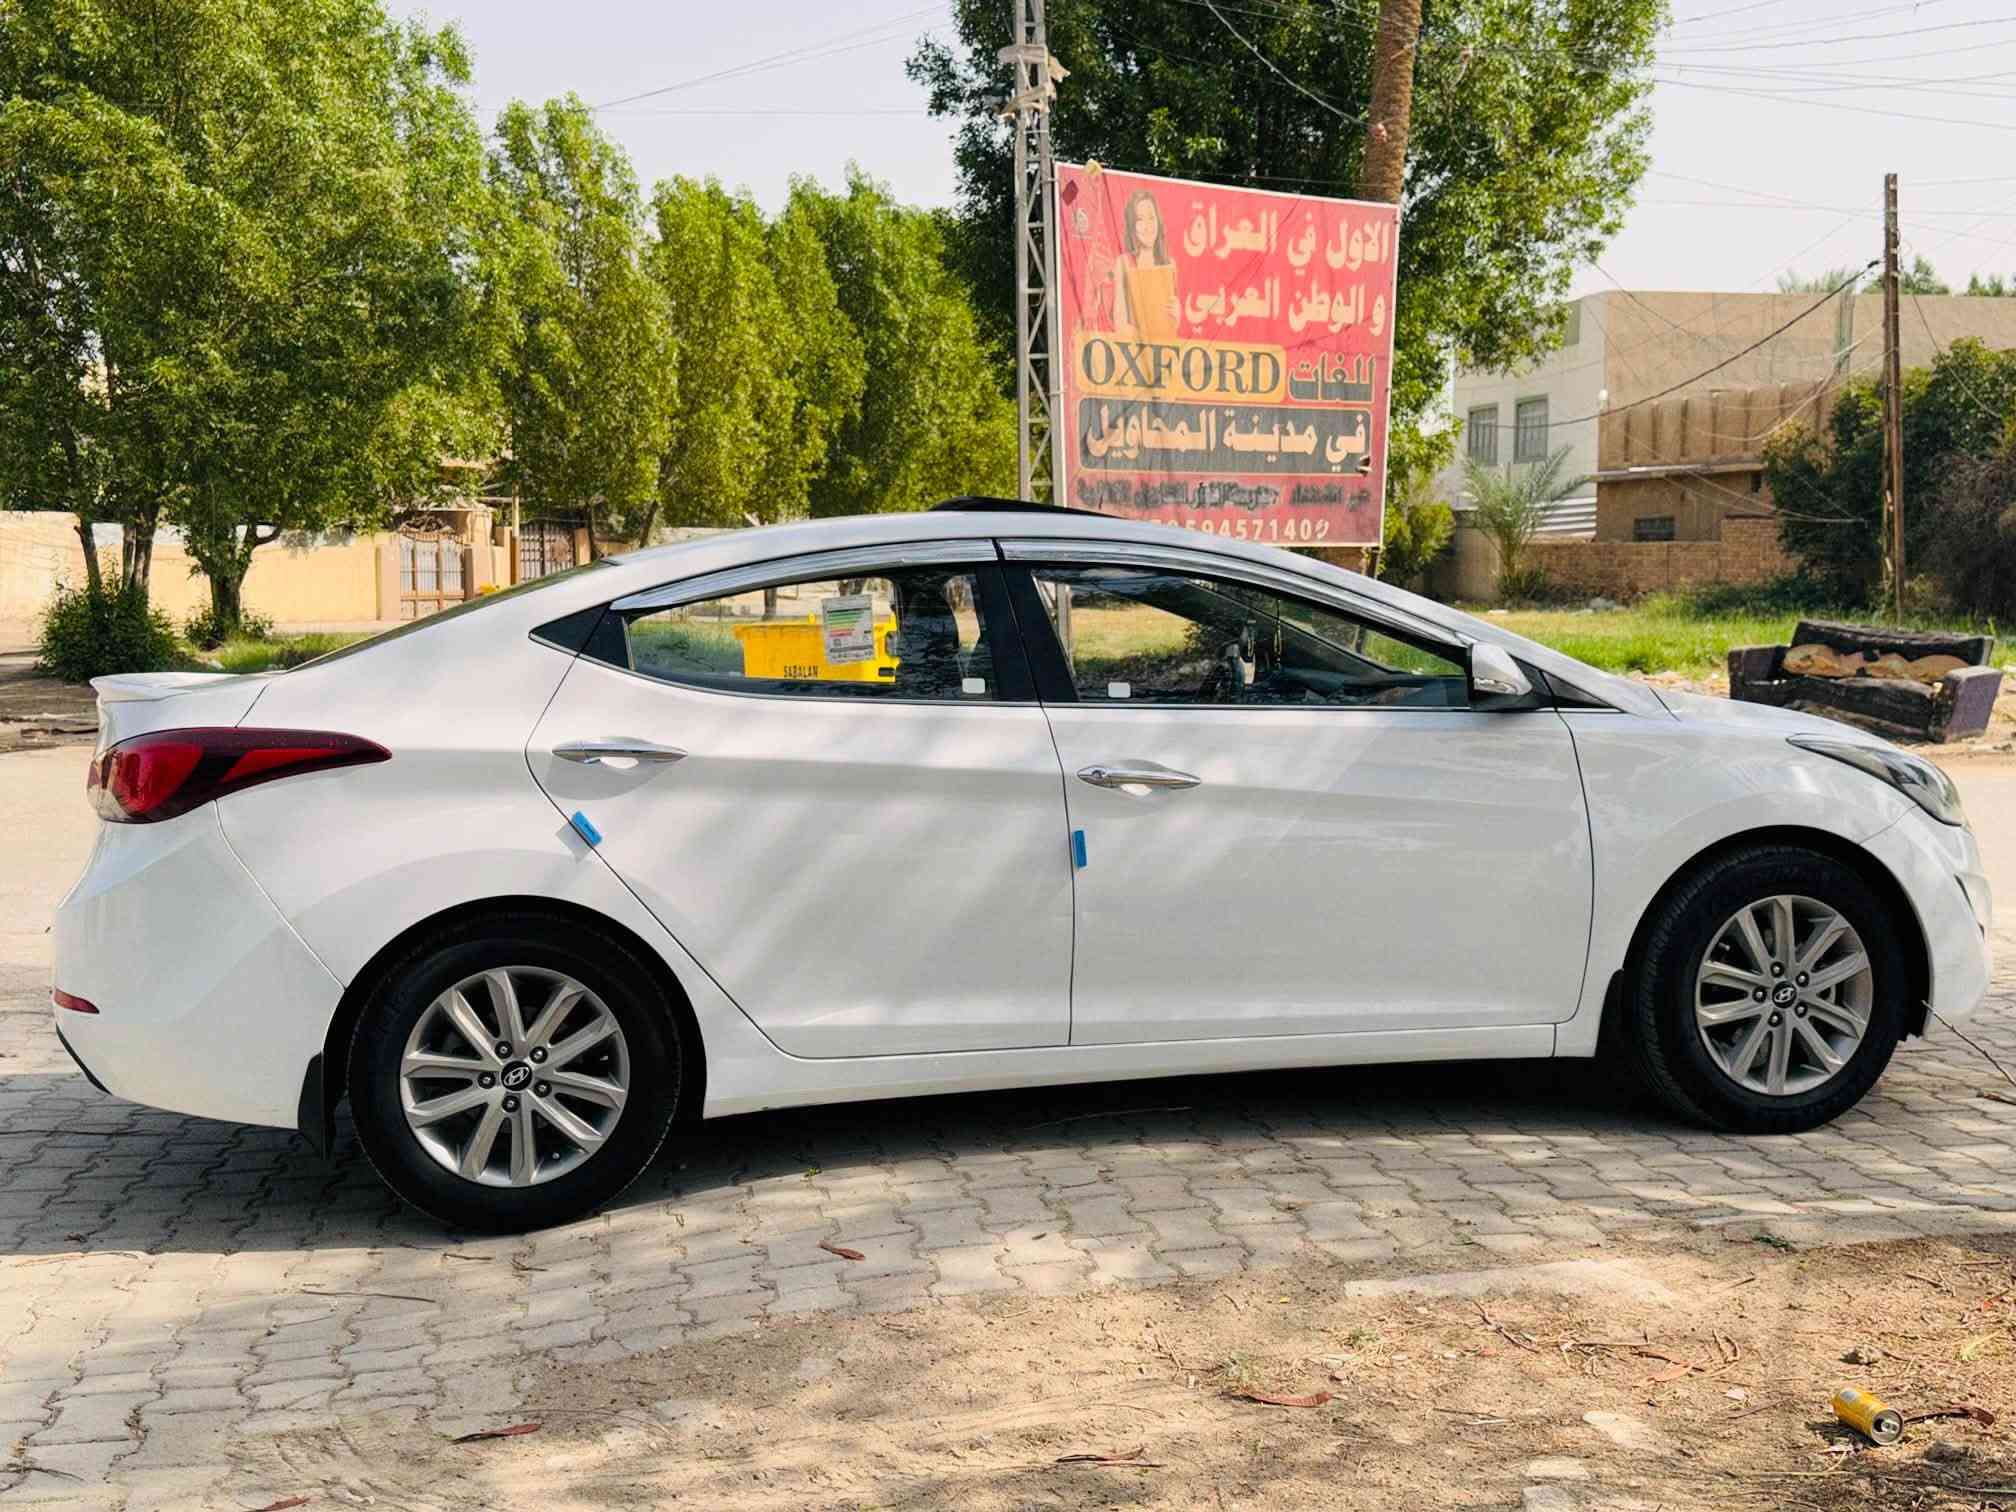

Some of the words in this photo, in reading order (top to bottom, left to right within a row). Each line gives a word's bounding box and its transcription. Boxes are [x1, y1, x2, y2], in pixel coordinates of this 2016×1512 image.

[1183, 201, 1279, 260] العراق
[1287, 211, 1317, 276] في
[1326, 219, 1391, 271] الاول
[1185, 276, 1280, 334] العربي
[1288, 278, 1365, 333] الوطن
[1369, 293, 1386, 336] و
[1082, 338, 1281, 394] OXFORD
[1288, 351, 1376, 403] للغات
[1086, 403, 1216, 459] المحاويل
[1223, 408, 1318, 463] مدينة
[1325, 413, 1366, 472] في
